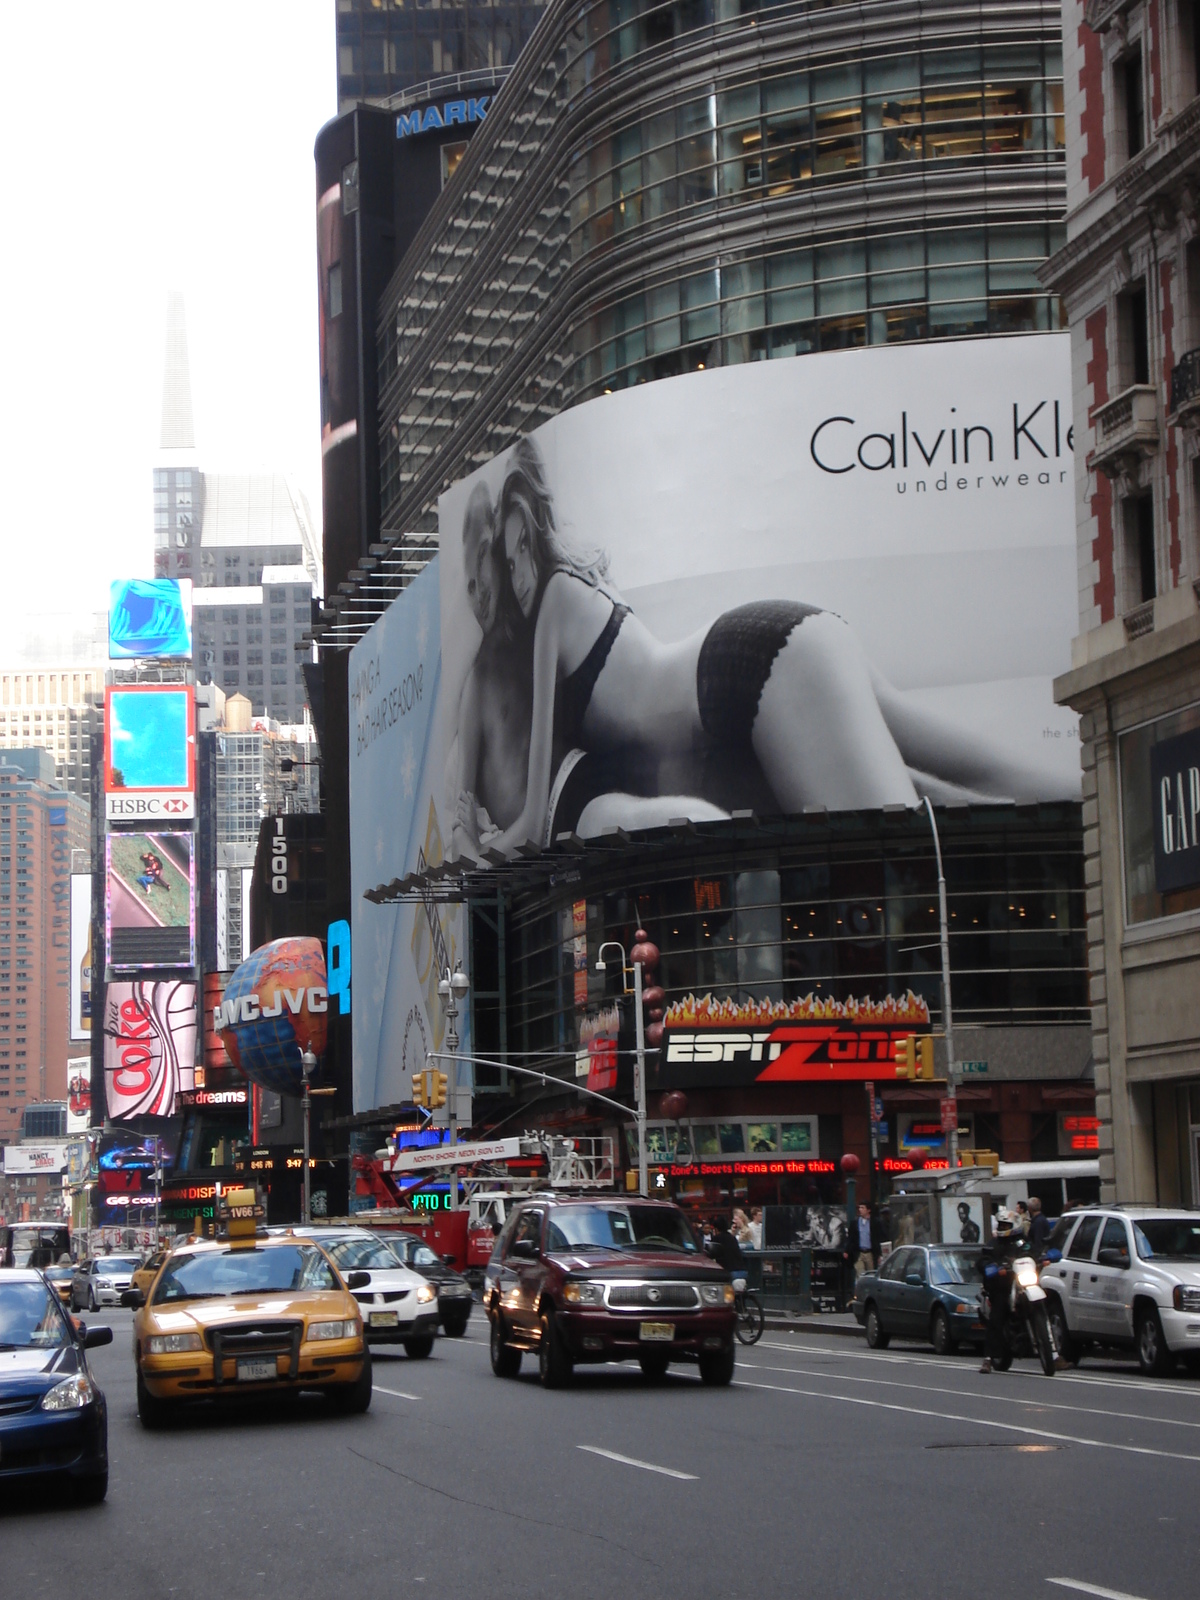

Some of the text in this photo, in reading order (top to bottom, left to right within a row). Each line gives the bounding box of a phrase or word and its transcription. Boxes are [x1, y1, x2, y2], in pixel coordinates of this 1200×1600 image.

[397, 95, 497, 138] MARK
[810, 400, 1074, 474] Calvin Kl
[897, 471, 1067, 494] underwear
[357, 663, 424, 757] BAD HAIR SEASON?
[1042, 728, 1062, 739] the
[110, 799, 160, 814] HSBC
[1161, 766, 1200, 855] GAP
[271, 817, 288, 894] 1500
[262, 987, 328, 1018] JVC
[108, 1001, 119, 1040] Diet
[112, 999, 151, 1097] Coke
[666, 1033, 782, 1063] ESPN
[196, 1091, 247, 1104] dreams
[35, 1158, 54, 1166] GRACE
[413, 1154, 434, 1163] NORTH
[435, 1152, 456, 1160] SHORE
[458, 1150, 476, 1158] NEON
[477, 1147, 493, 1156] SIGN
[671, 1164, 699, 1176] Zone's
[701, 1163, 733, 1175] Sports
[734, 1161, 768, 1175] Arena
[770, 1162, 784, 1173] on
[786, 1160, 805, 1172] the
[106, 1196, 129, 1205] G6
[230, 1206, 254, 1219] 1V66
